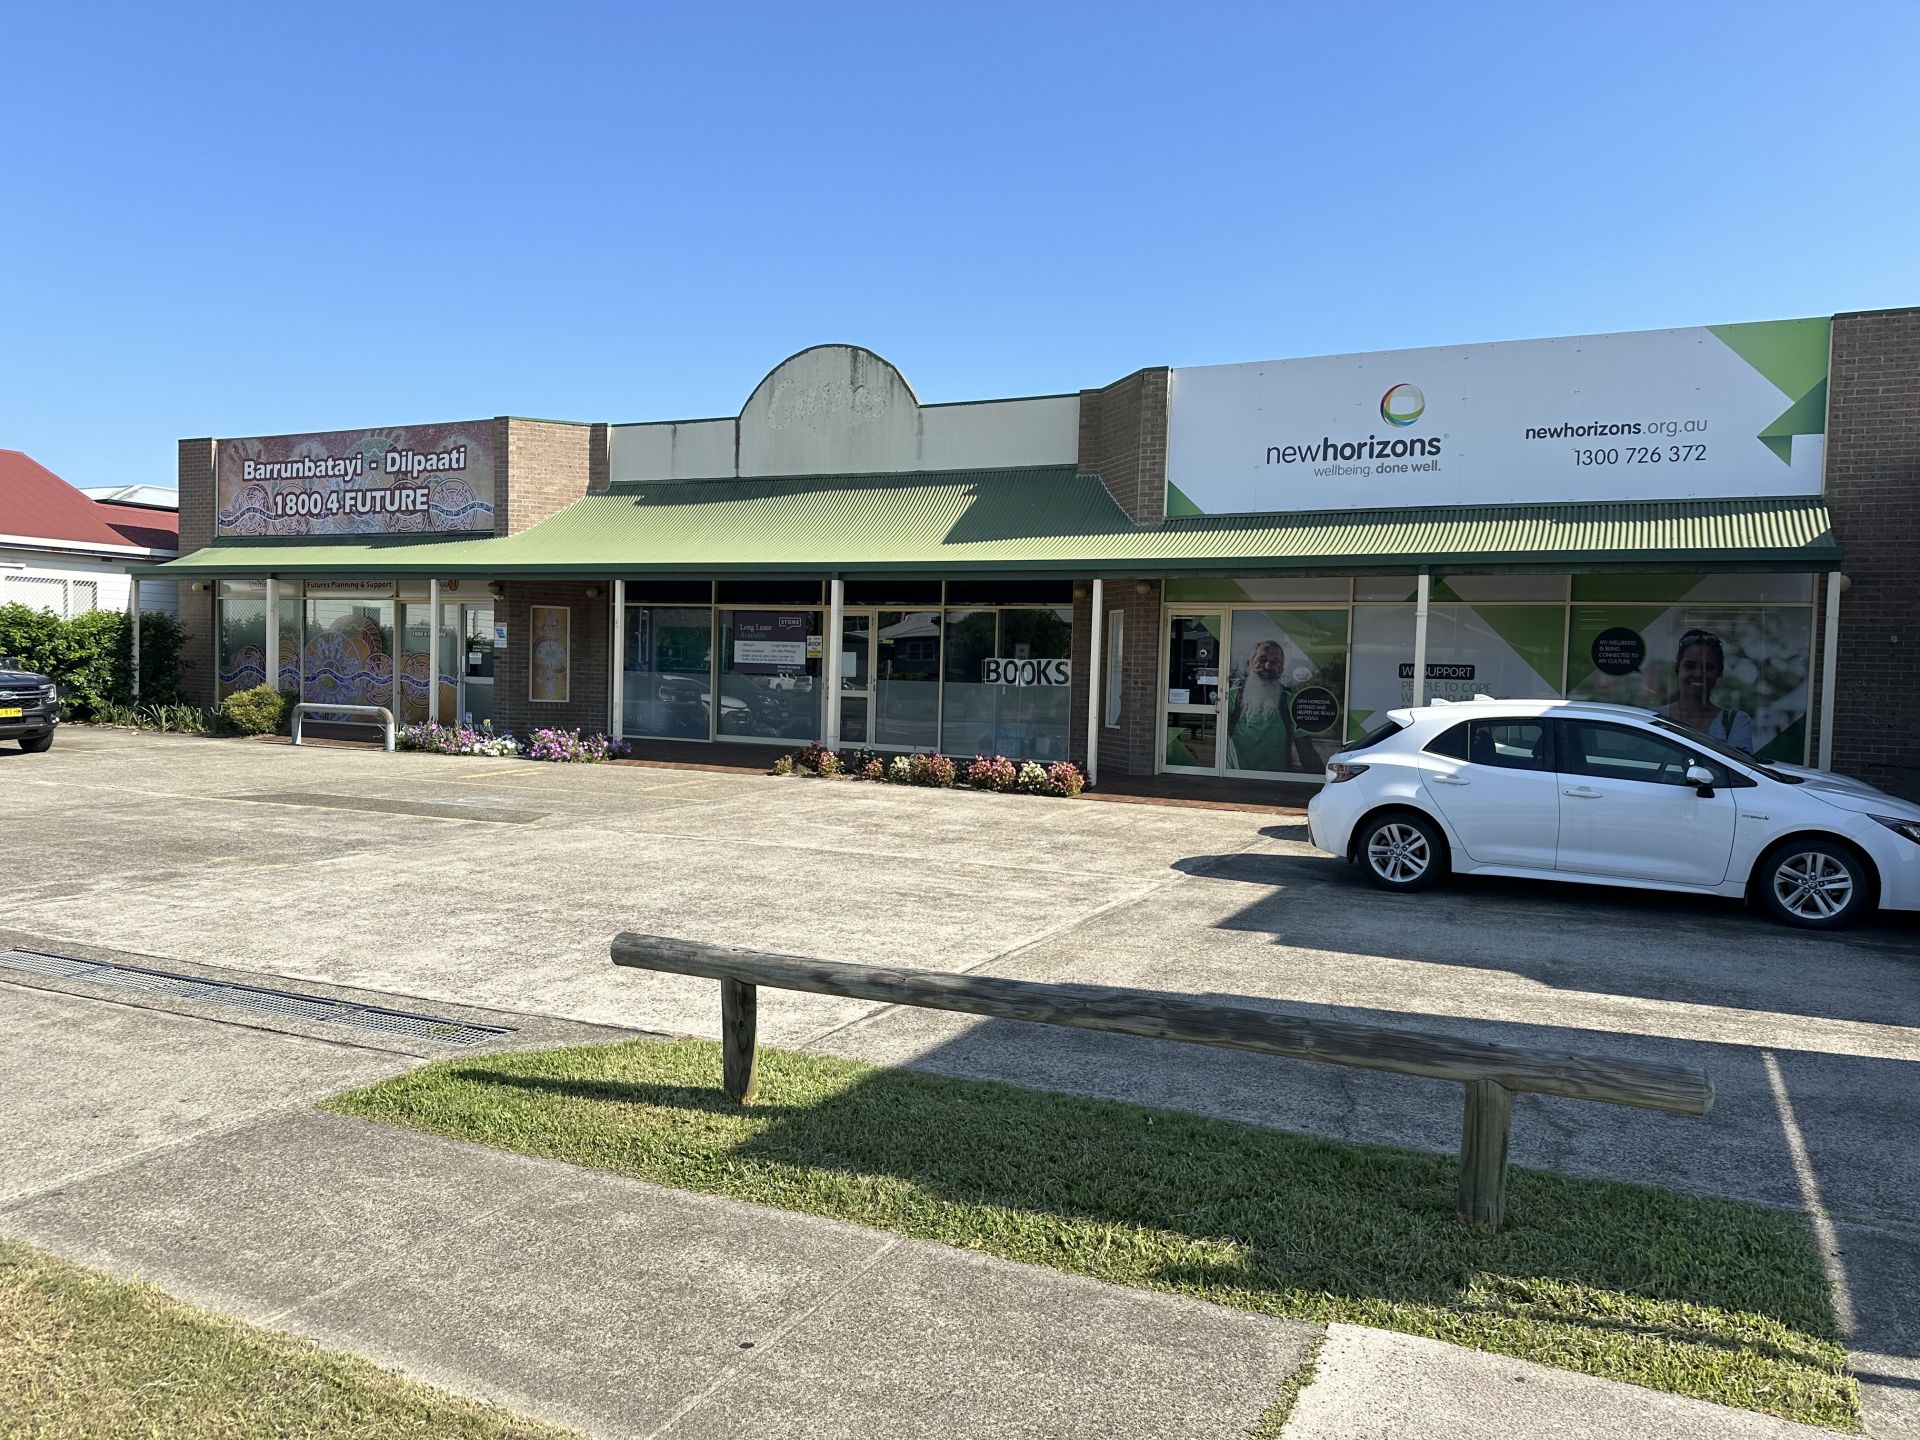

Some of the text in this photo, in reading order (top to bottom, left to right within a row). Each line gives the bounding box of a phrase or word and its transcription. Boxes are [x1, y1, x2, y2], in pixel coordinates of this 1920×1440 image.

[1525, 419, 1707, 439] newhorizons.org.au
[1266, 434, 1441, 465] newhorizons
[1574, 444, 1707, 466] 1300 726 372
[243, 454, 362, 481] Barrunbatayi
[386, 447, 466, 478] Dilpaati
[1313, 459, 1441, 478] wellbeing. done well.
[275, 488, 429, 516] 1800 4 FUTURE
[332, 581, 359, 590] Planning
[367, 581, 392, 589] Support
[739, 623, 772, 633] Long Lease
[985, 659, 1070, 686] BOOKS
[1402, 666, 1414, 677] W
[1401, 681, 1492, 694] PEPLE TO COPE
